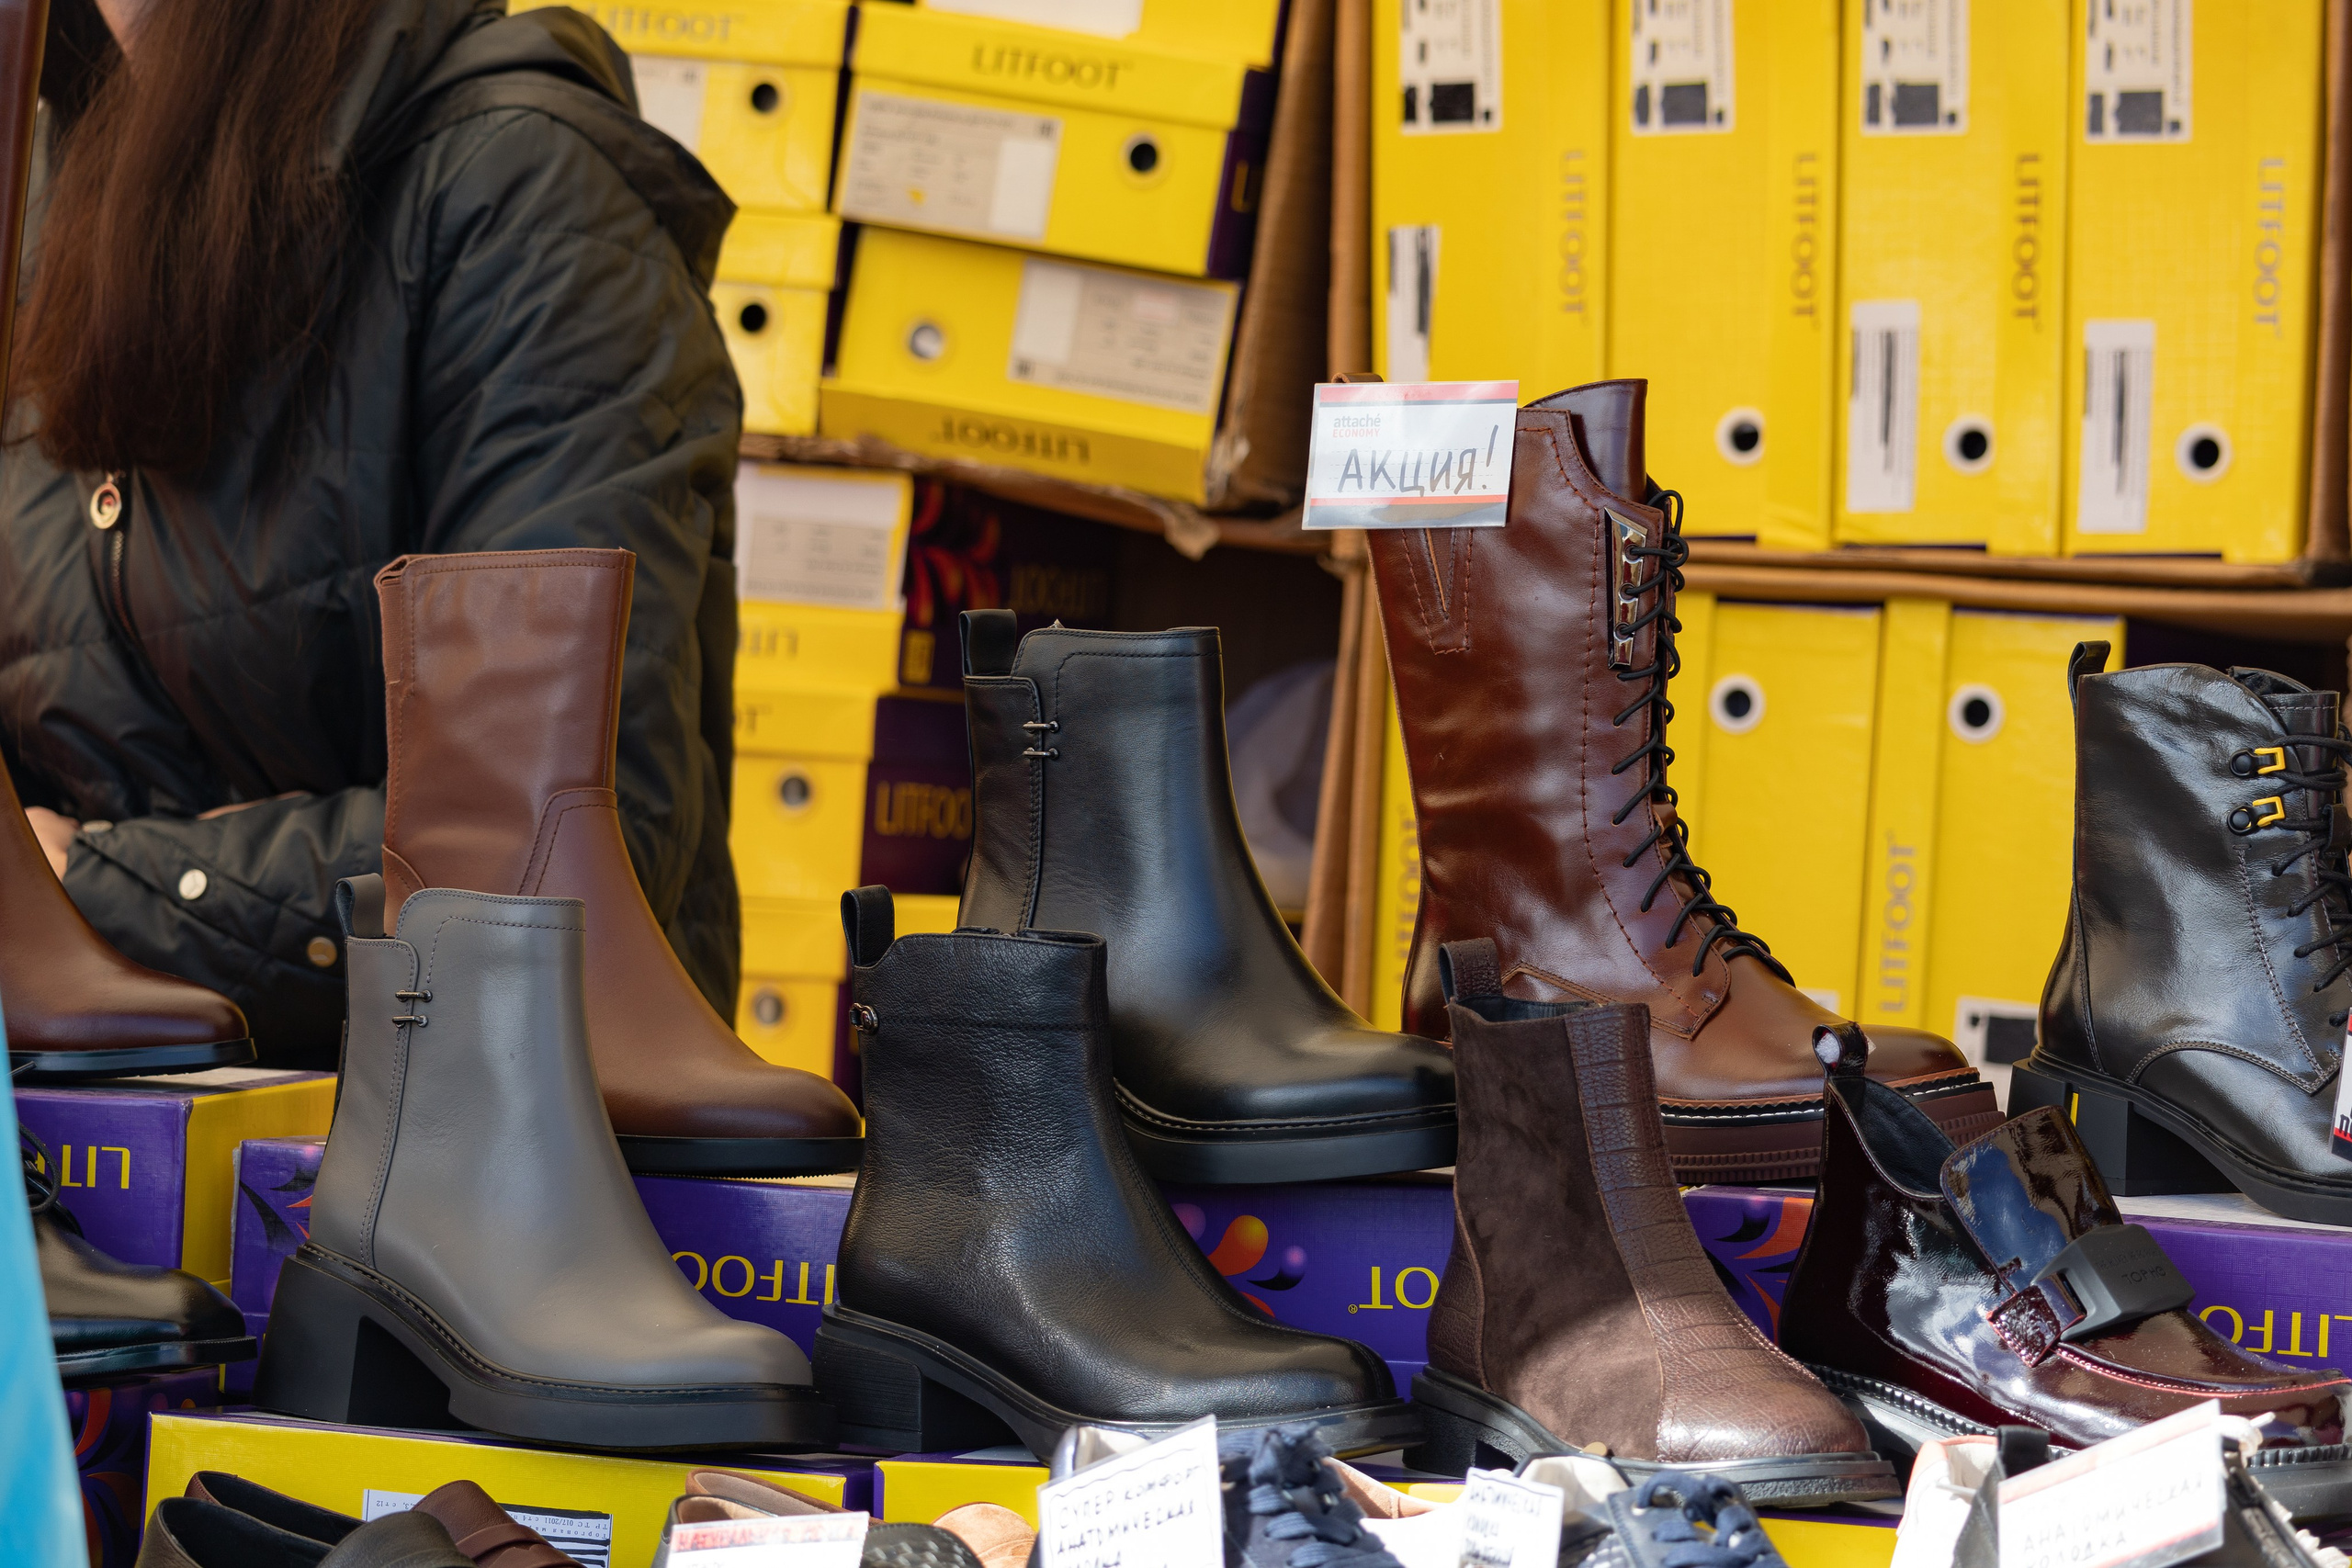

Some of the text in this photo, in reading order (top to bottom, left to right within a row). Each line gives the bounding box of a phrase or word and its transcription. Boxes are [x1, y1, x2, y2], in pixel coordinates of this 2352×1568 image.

[971, 41, 1124, 90] LITFOOT
[2012, 152, 2041, 320] LITFOOT
[2254, 157, 2285, 326] LITFOOT
[1333, 428, 1380, 438] ECONOMY
[1334, 413, 1381, 428] attaché
[1338, 424, 1499, 497] АКЦИЯ!
[1880, 844, 1917, 1012] LITFOOT
[544, 1517, 574, 1527] 017/2011
